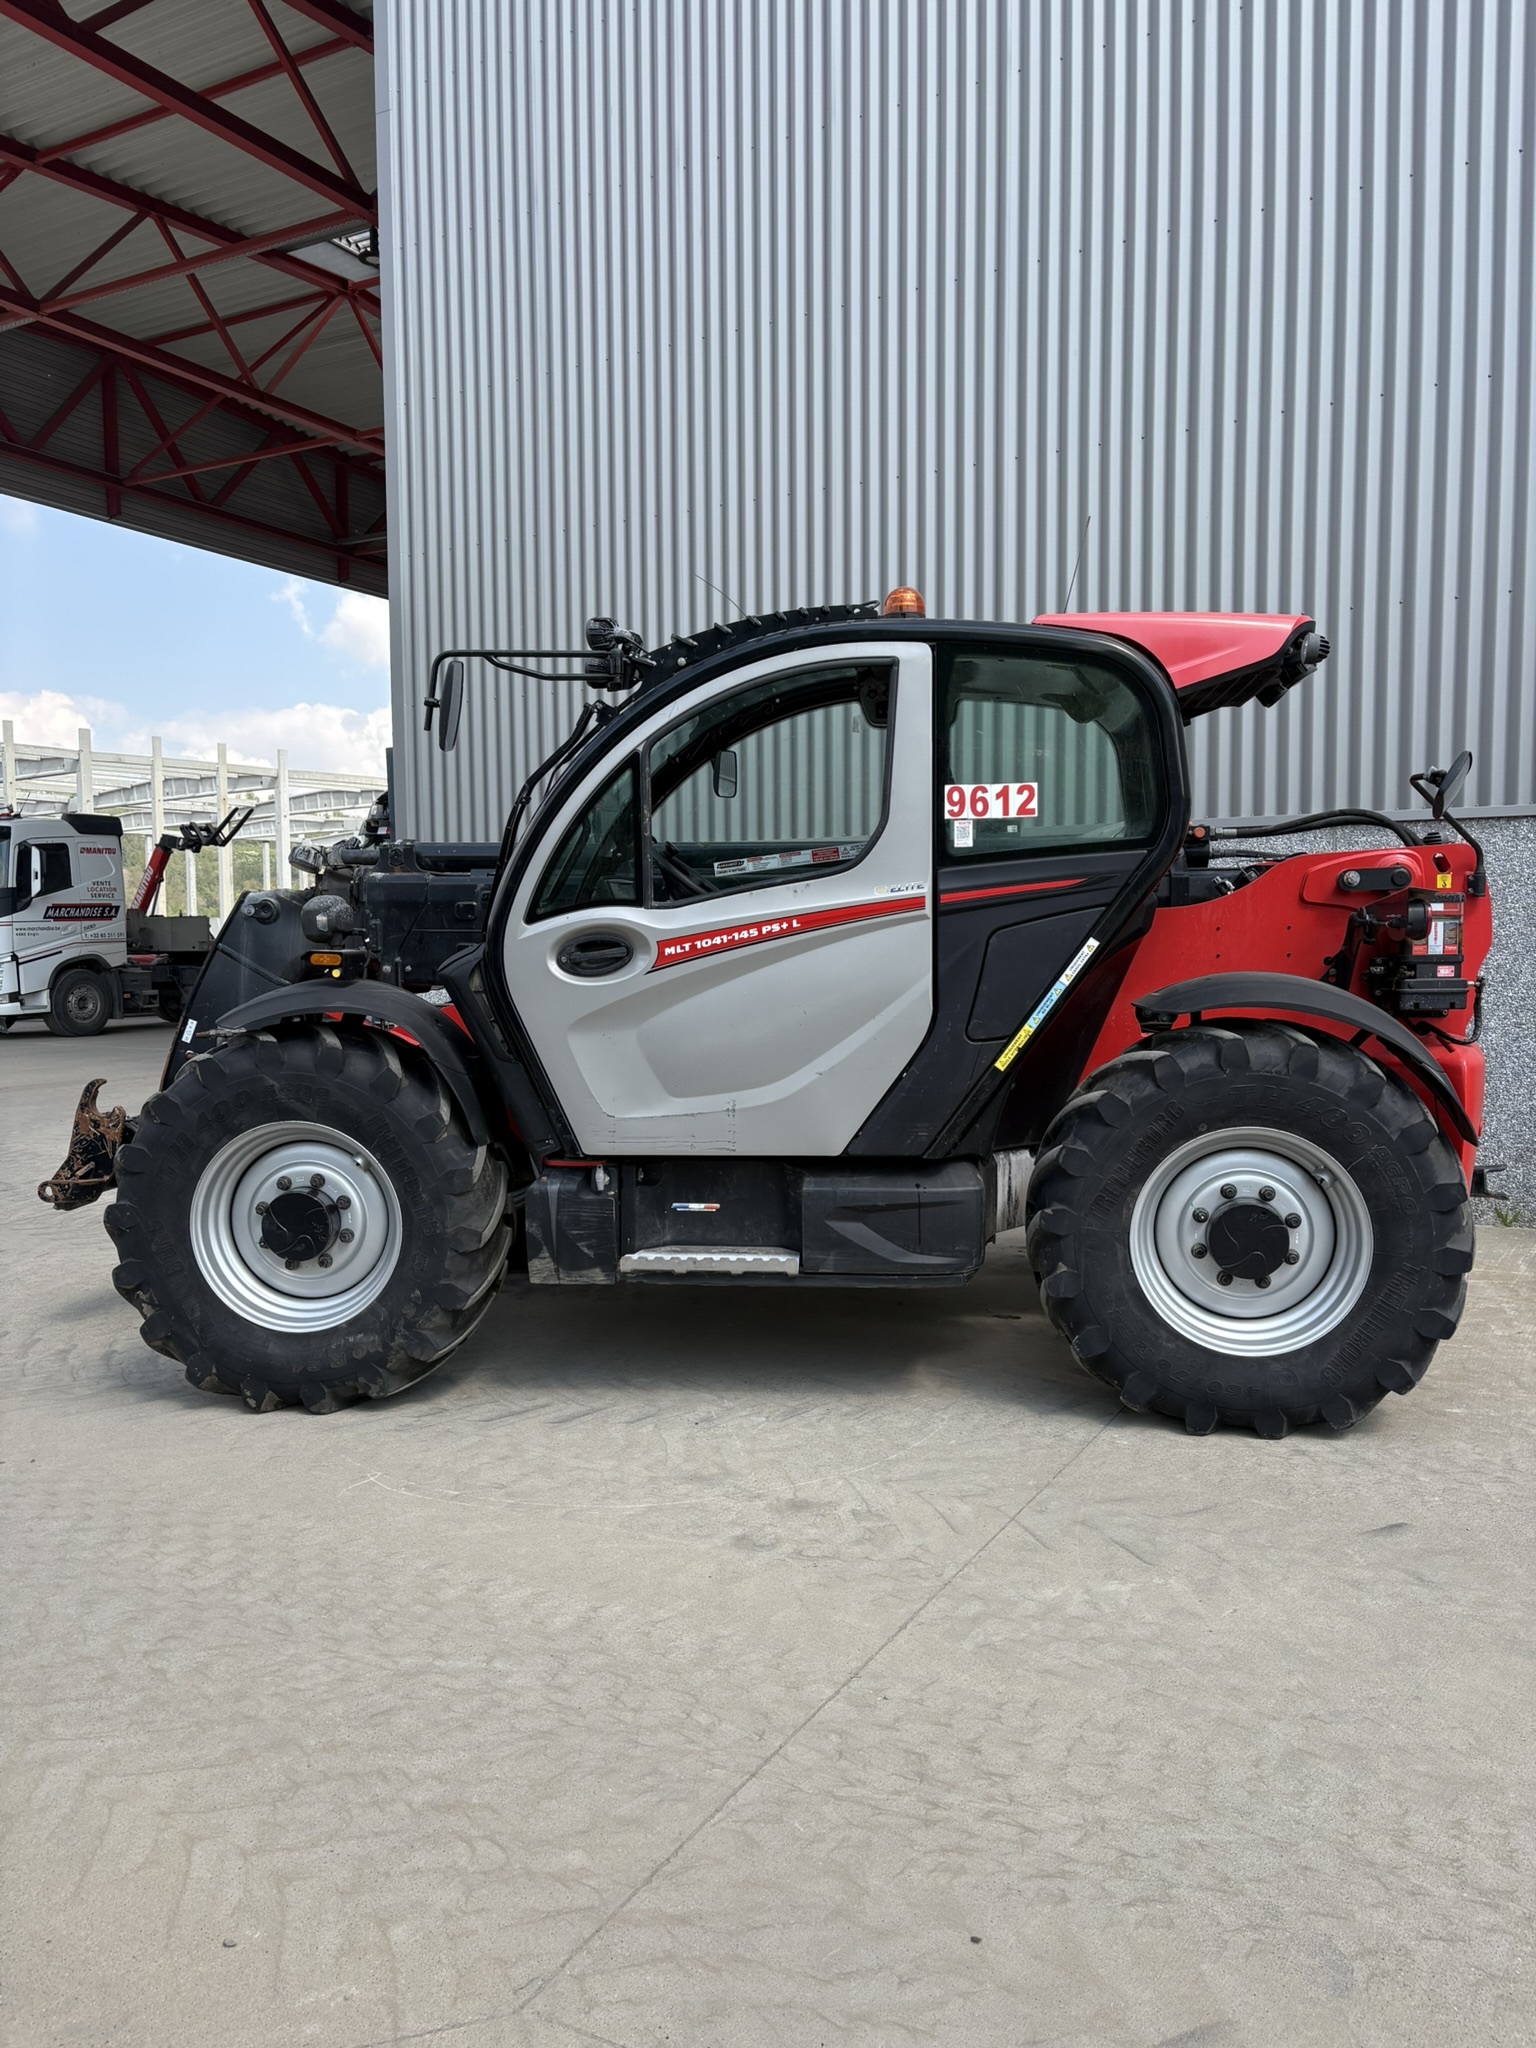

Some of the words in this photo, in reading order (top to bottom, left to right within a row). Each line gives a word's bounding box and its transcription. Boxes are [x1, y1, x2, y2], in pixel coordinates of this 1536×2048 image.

[946, 784, 1036, 818] 9612
[85, 847, 117, 855] MANITOU
[131, 865, 154, 910] MANITOU
[890, 881, 925, 893] ELITE
[46, 907, 102, 917] MARCHANDISE
[103, 907, 117, 917] S.A.
[664, 942, 692, 956] MLT
[694, 928, 759, 949] 1041-145
[761, 922, 789, 935] PS+
[792, 919, 801, 928] L
[1081, 1100, 1185, 1226] TRELLEBORG
[1320, 1262, 1428, 1388] TRELLEBORG
